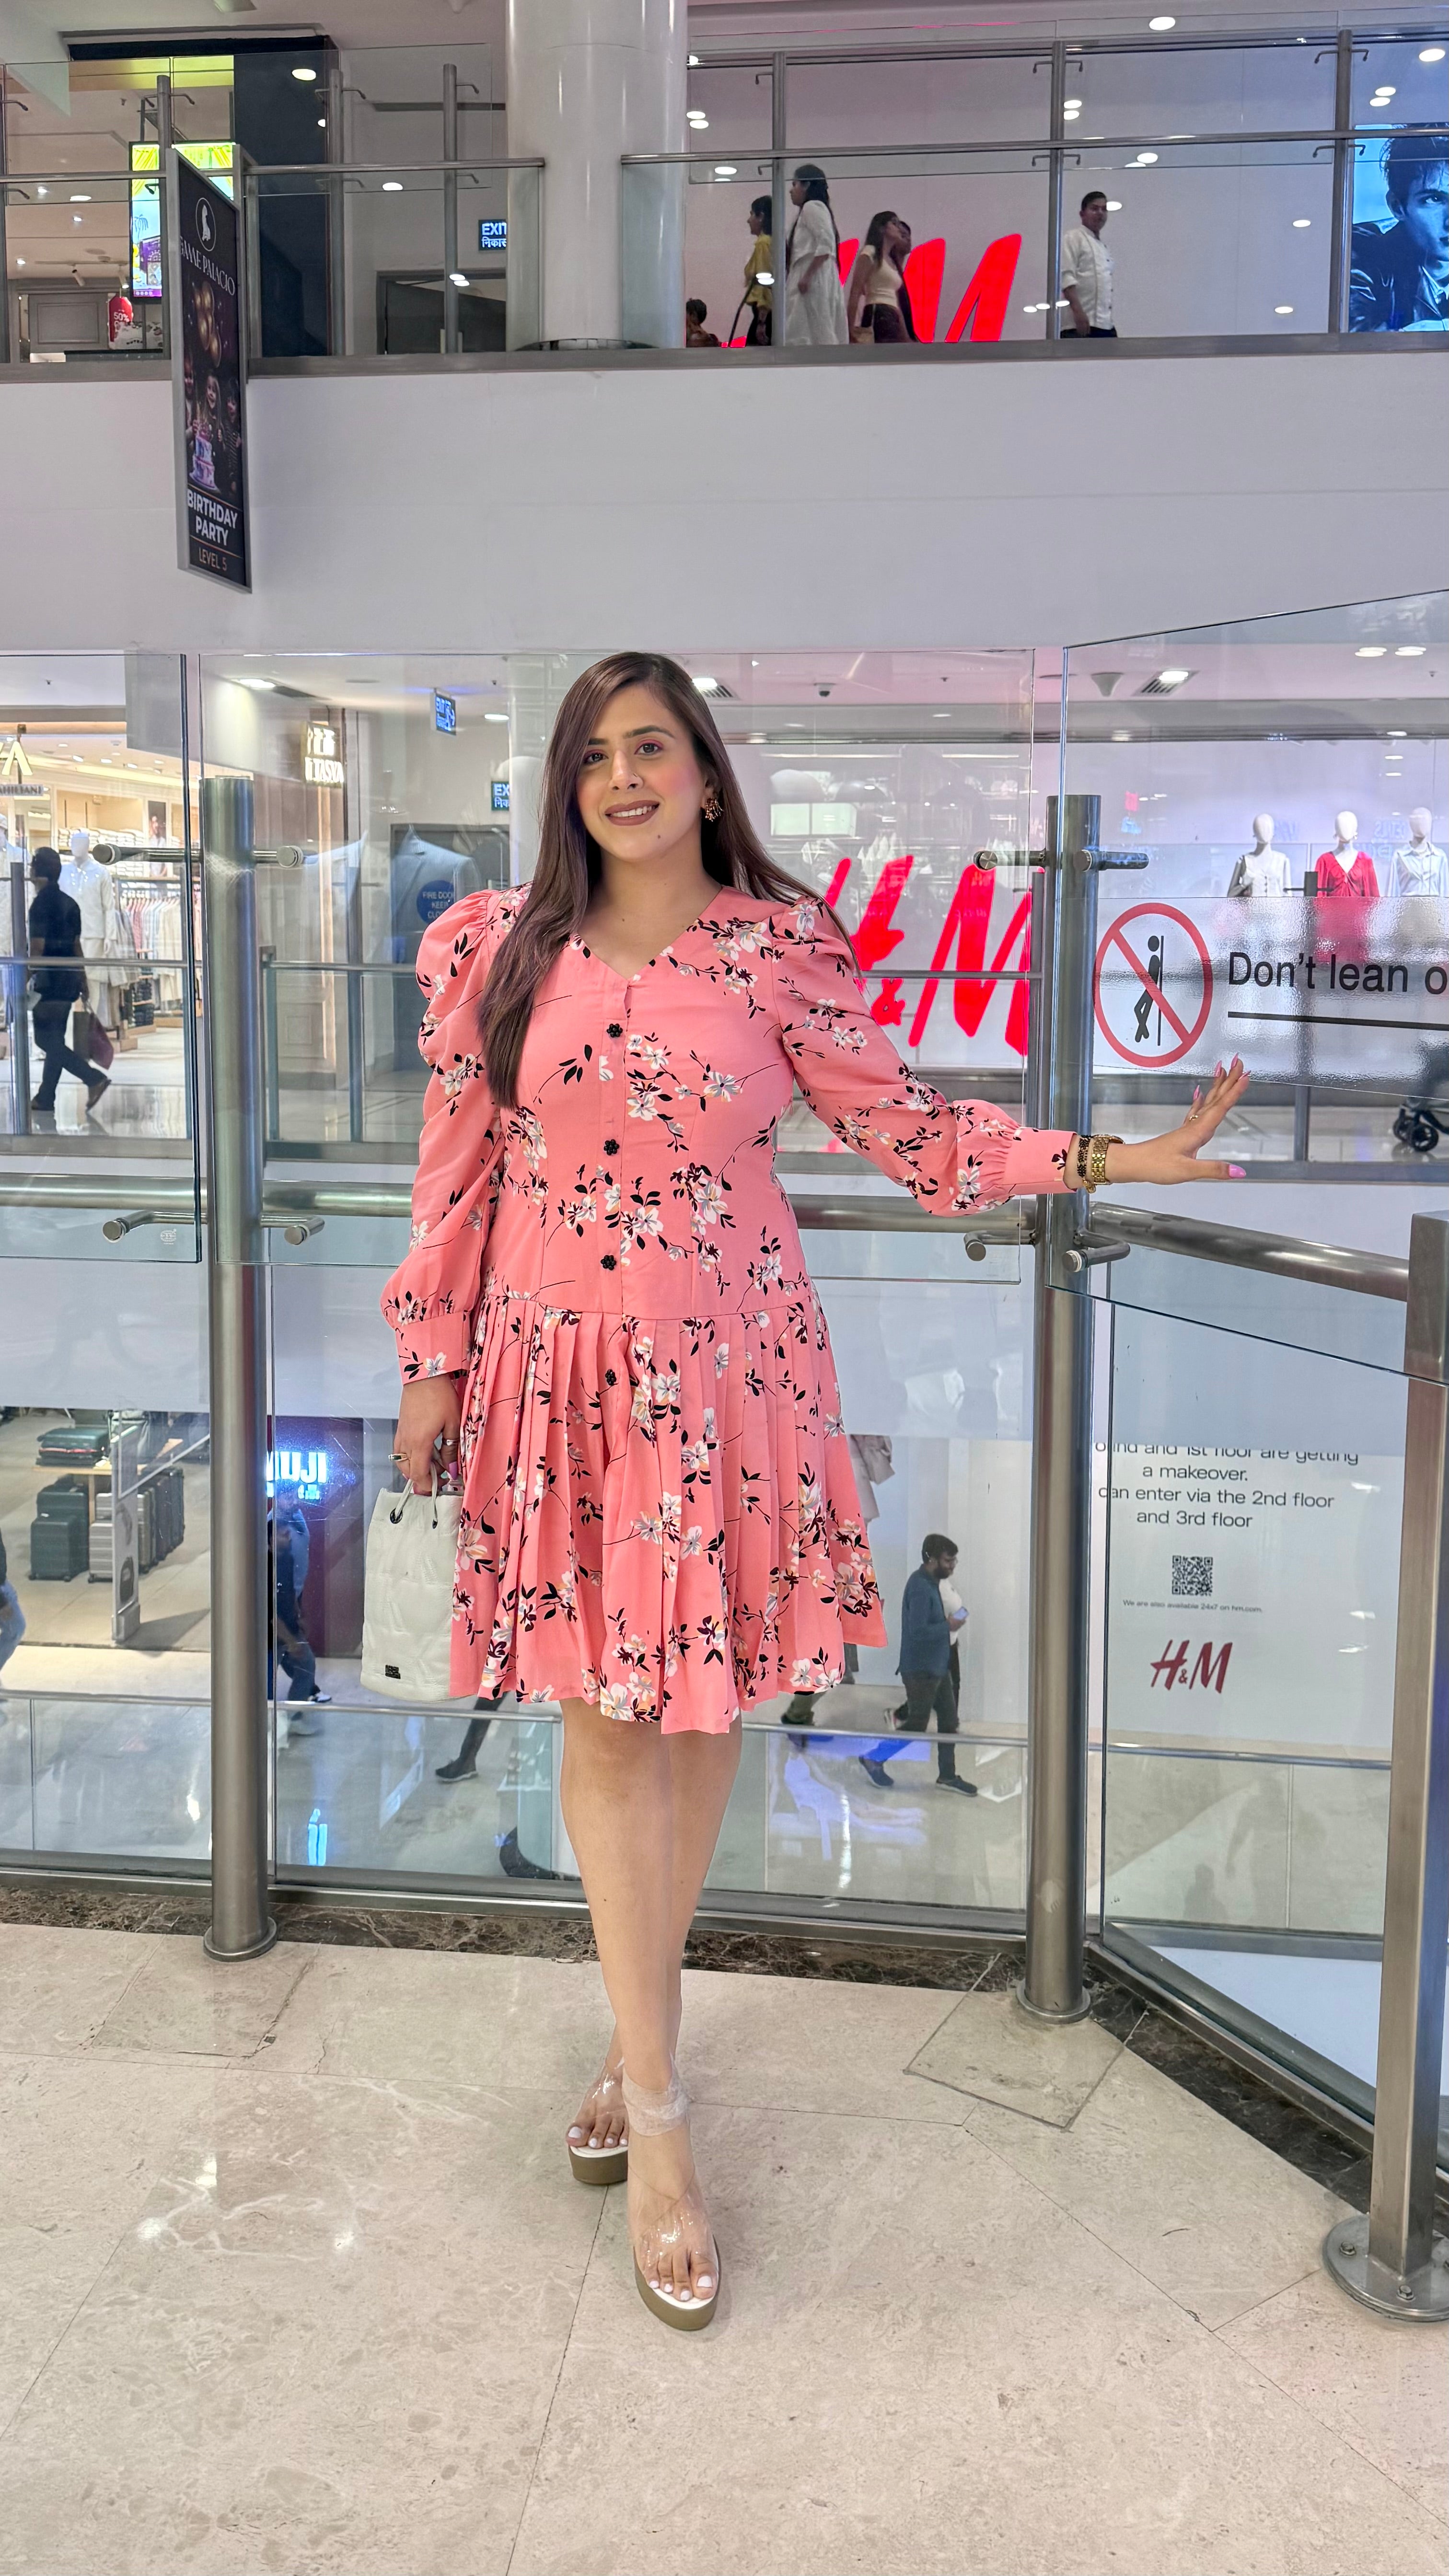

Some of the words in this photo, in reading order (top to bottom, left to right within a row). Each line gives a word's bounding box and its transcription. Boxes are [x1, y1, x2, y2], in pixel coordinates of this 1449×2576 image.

[482, 222, 507, 235] EXIT
[203, 255, 235, 296] PALACIO
[187, 489, 238, 529] BIRTHDAY
[196, 515, 229, 546] PARTY
[199, 547, 220, 569] LEVEL
[222, 556, 227, 571] 5
[494, 783, 510, 796] EX
[1229, 951, 1317, 989] Don't
[1330, 954, 1408, 993] lean
[1142, 1466, 1153, 1477] a
[1159, 1465, 1248, 1481] makeover.
[1098, 1487, 1129, 1499] can
[1136, 1487, 1182, 1502] enter
[1186, 1488, 1211, 1502] via
[1217, 1489, 1246, 1504] the
[1252, 1490, 1287, 1506] 2nd
[1292, 1492, 1335, 1508] floor
[1136, 1510, 1170, 1524] and
[1176, 1510, 1205, 1526] 3rd
[1211, 1512, 1253, 1527] floor
[1150, 1639, 1233, 1694] H&M
